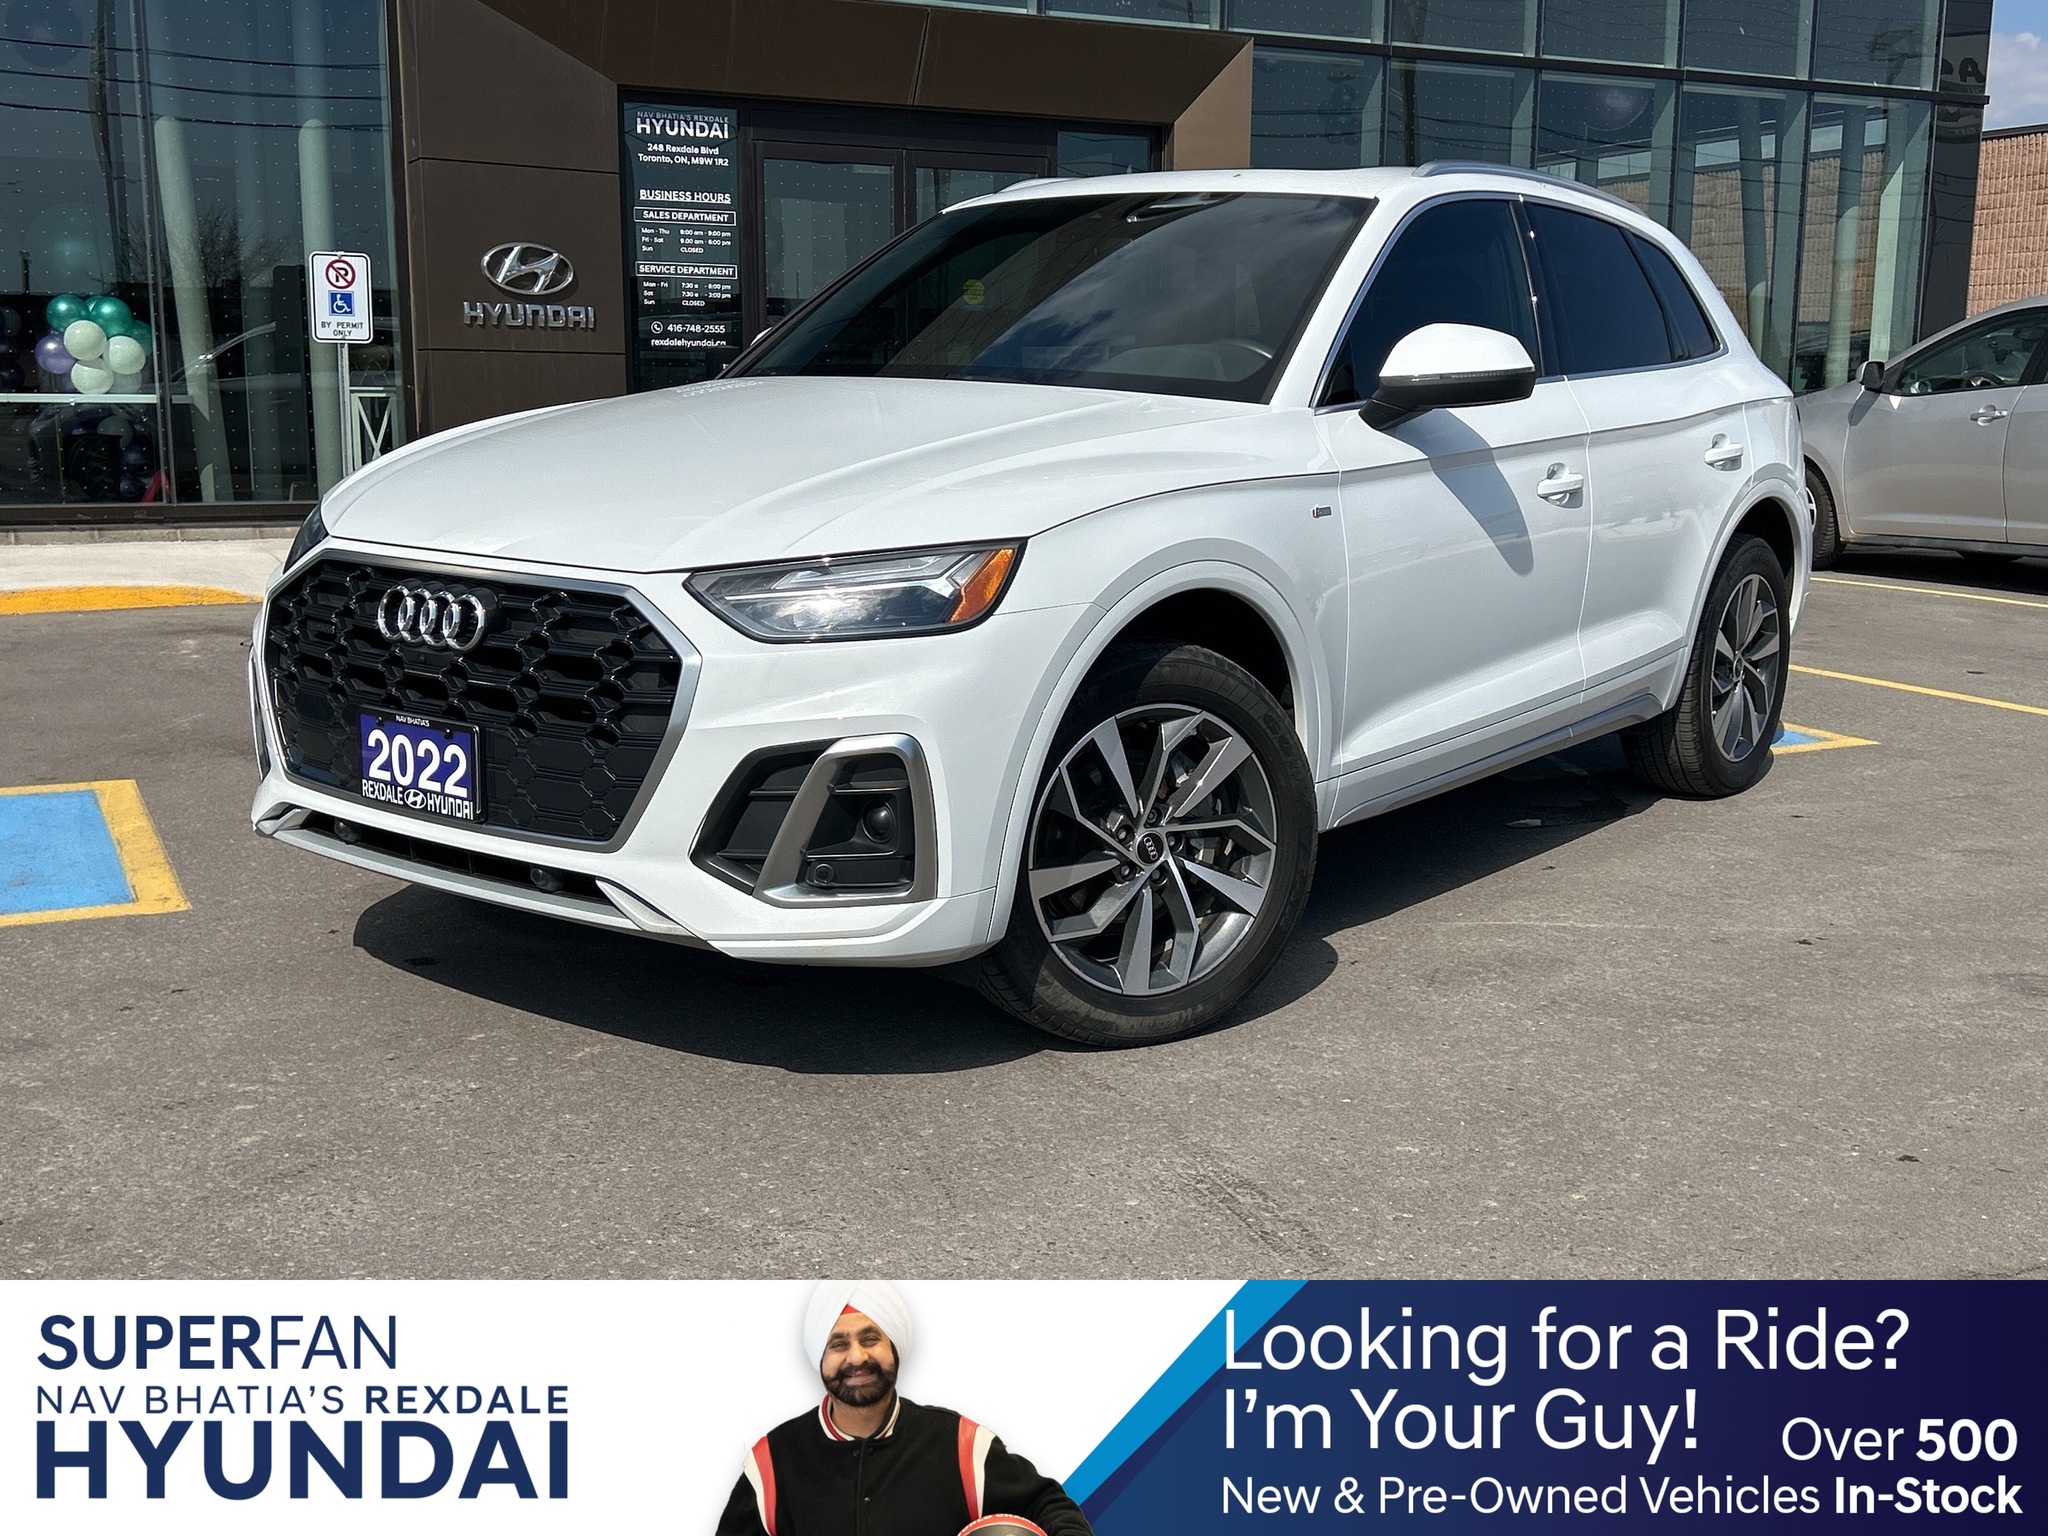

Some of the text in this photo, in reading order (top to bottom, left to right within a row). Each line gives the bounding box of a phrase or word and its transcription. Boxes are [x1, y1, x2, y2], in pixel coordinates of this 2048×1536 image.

[637, 111, 654, 119] NAV
[694, 115, 729, 123] REXDALE
[636, 118, 729, 139] HYUNDAI
[647, 143, 719, 155] 248 Rexdale Blvd
[638, 153, 729, 166] Toronto, ON, M9W 1R2
[640, 189, 731, 202] BUSINESS HOURS
[643, 210, 729, 222] SALES DEPARTMENT
[639, 265, 734, 276] SERVICE DEPARTMENT
[463, 301, 595, 329] HYUNDAI
[321, 321, 332, 329] BY
[667, 323, 726, 333] 416-748-2555
[333, 329, 353, 337] ONLY
[395, 714, 407, 723] NAV
[367, 729, 468, 798] 2022
[362, 779, 474, 821] REXDALE HYUNDAI
